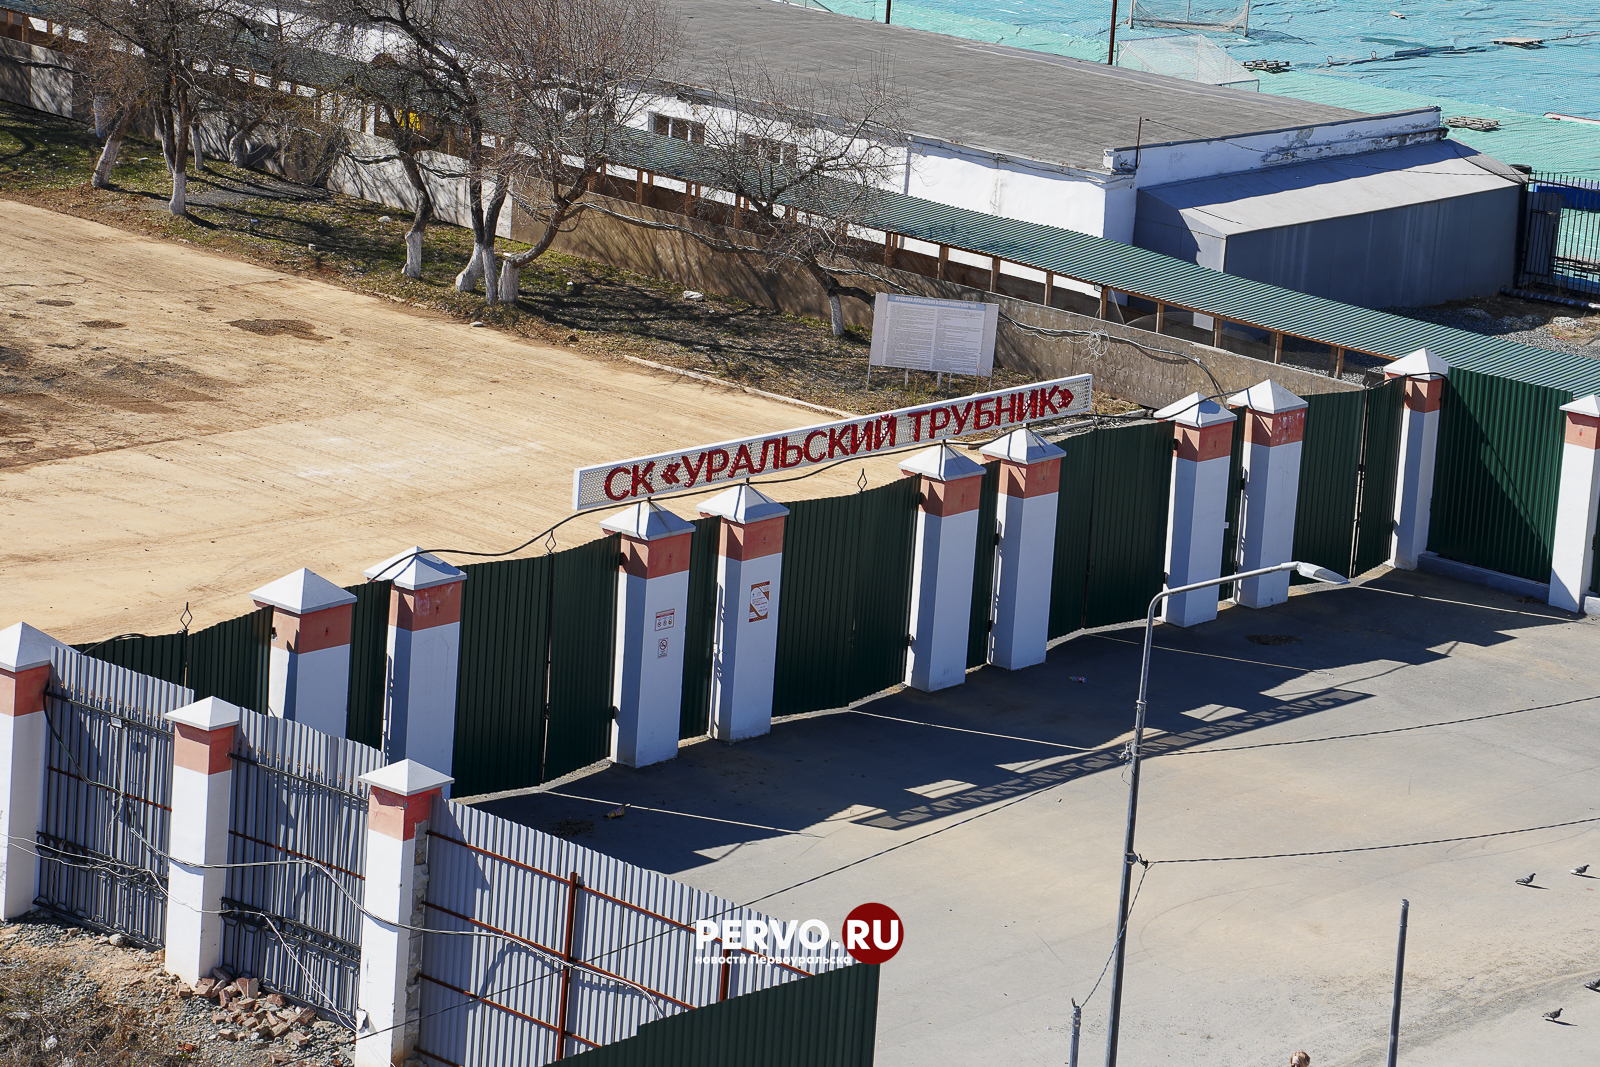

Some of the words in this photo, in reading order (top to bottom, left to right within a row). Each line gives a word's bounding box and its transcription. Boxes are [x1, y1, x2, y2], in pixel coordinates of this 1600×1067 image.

[604, 461, 656, 501] СК
[660, 413, 897, 488] «УРАЛЬСКИЙ
[907, 385, 1074, 442] ТРУБНИК»
